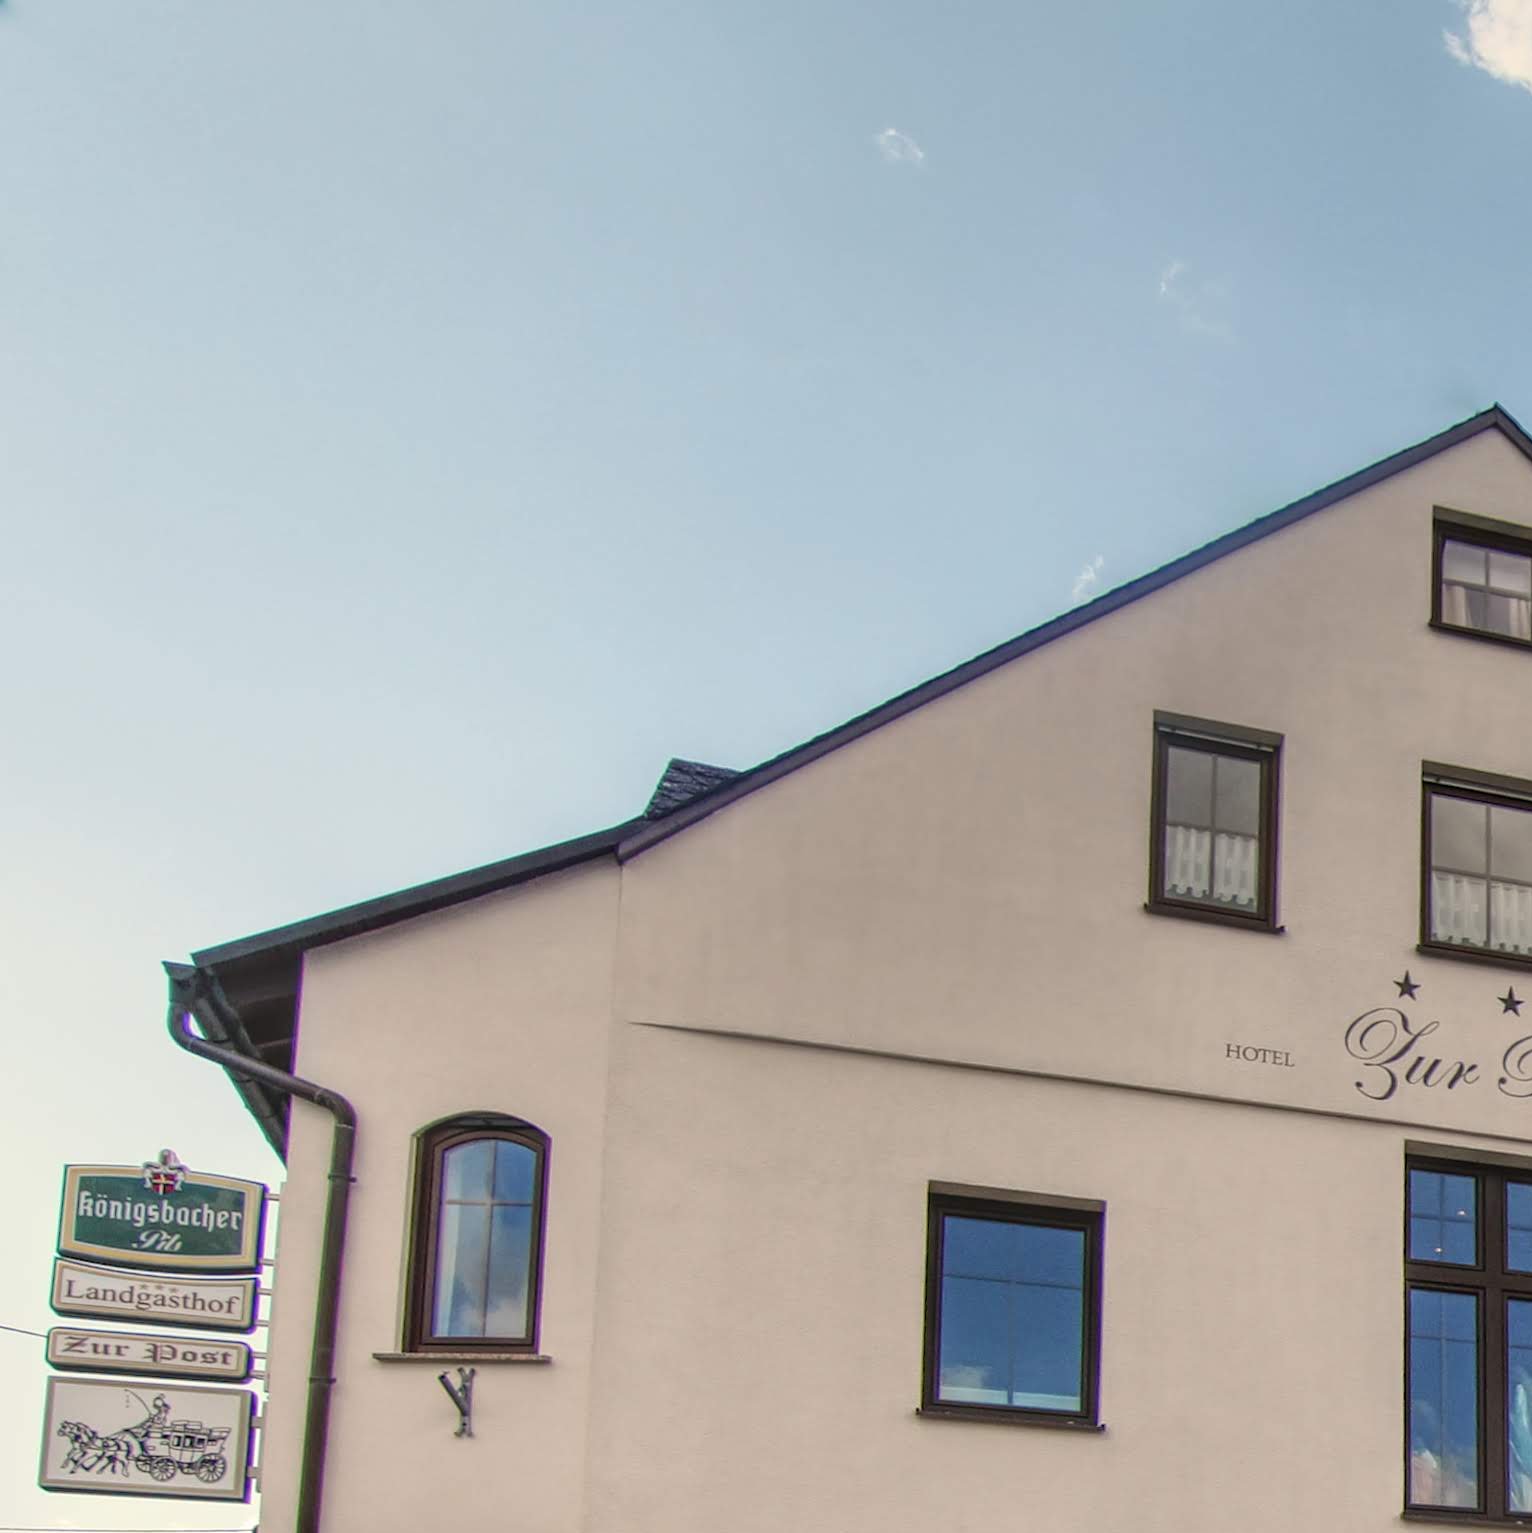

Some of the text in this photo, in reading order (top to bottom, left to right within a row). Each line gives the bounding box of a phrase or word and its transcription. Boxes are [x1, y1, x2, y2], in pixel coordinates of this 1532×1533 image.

[1225, 1043, 1296, 1069] HOTEL
[1344, 1007, 1480, 1101] Zur
[131, 1229, 183, 1251] Pils
[65, 1279, 240, 1315] Landgasthof
[62, 1335, 233, 1366] Zur Post
